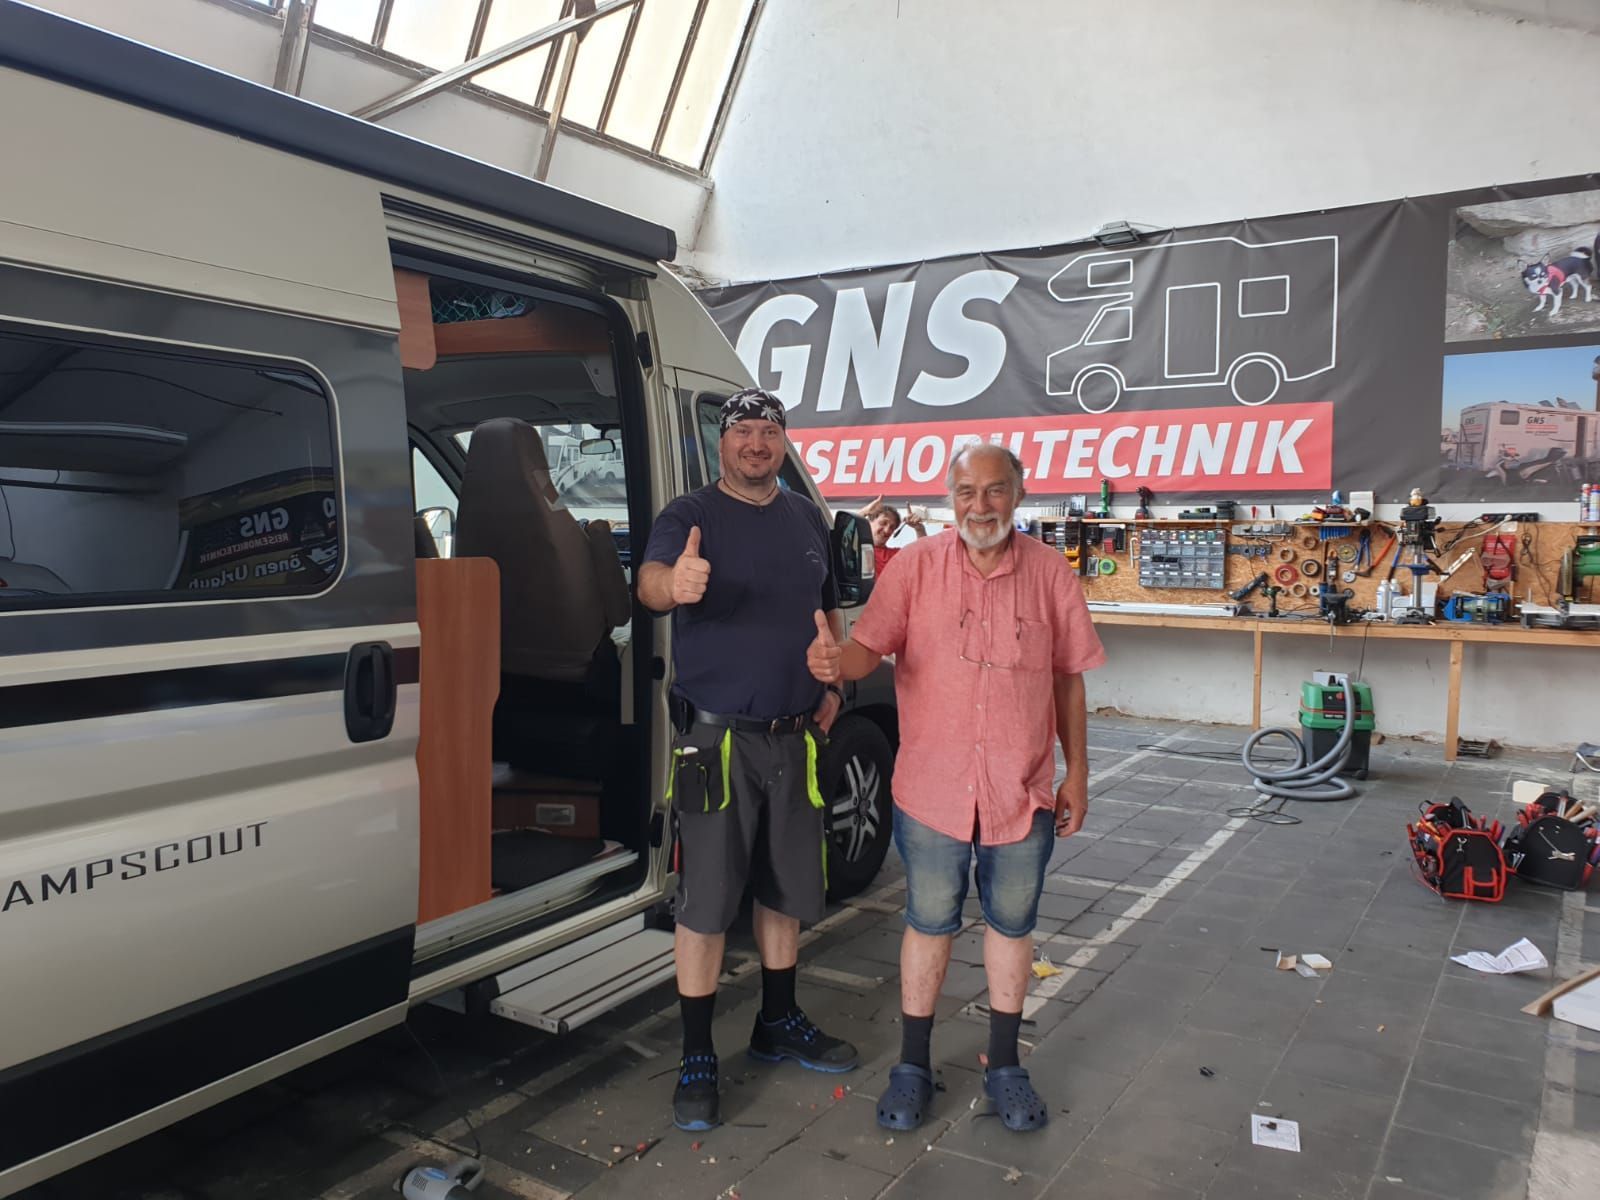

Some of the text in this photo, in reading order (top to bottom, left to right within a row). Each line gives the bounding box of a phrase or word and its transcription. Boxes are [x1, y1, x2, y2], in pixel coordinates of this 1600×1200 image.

[735, 269, 1019, 411] GNS
[796, 418, 1314, 485] SEMOLTECHNIK
[2, 820, 269, 912] AMPSCOUT
